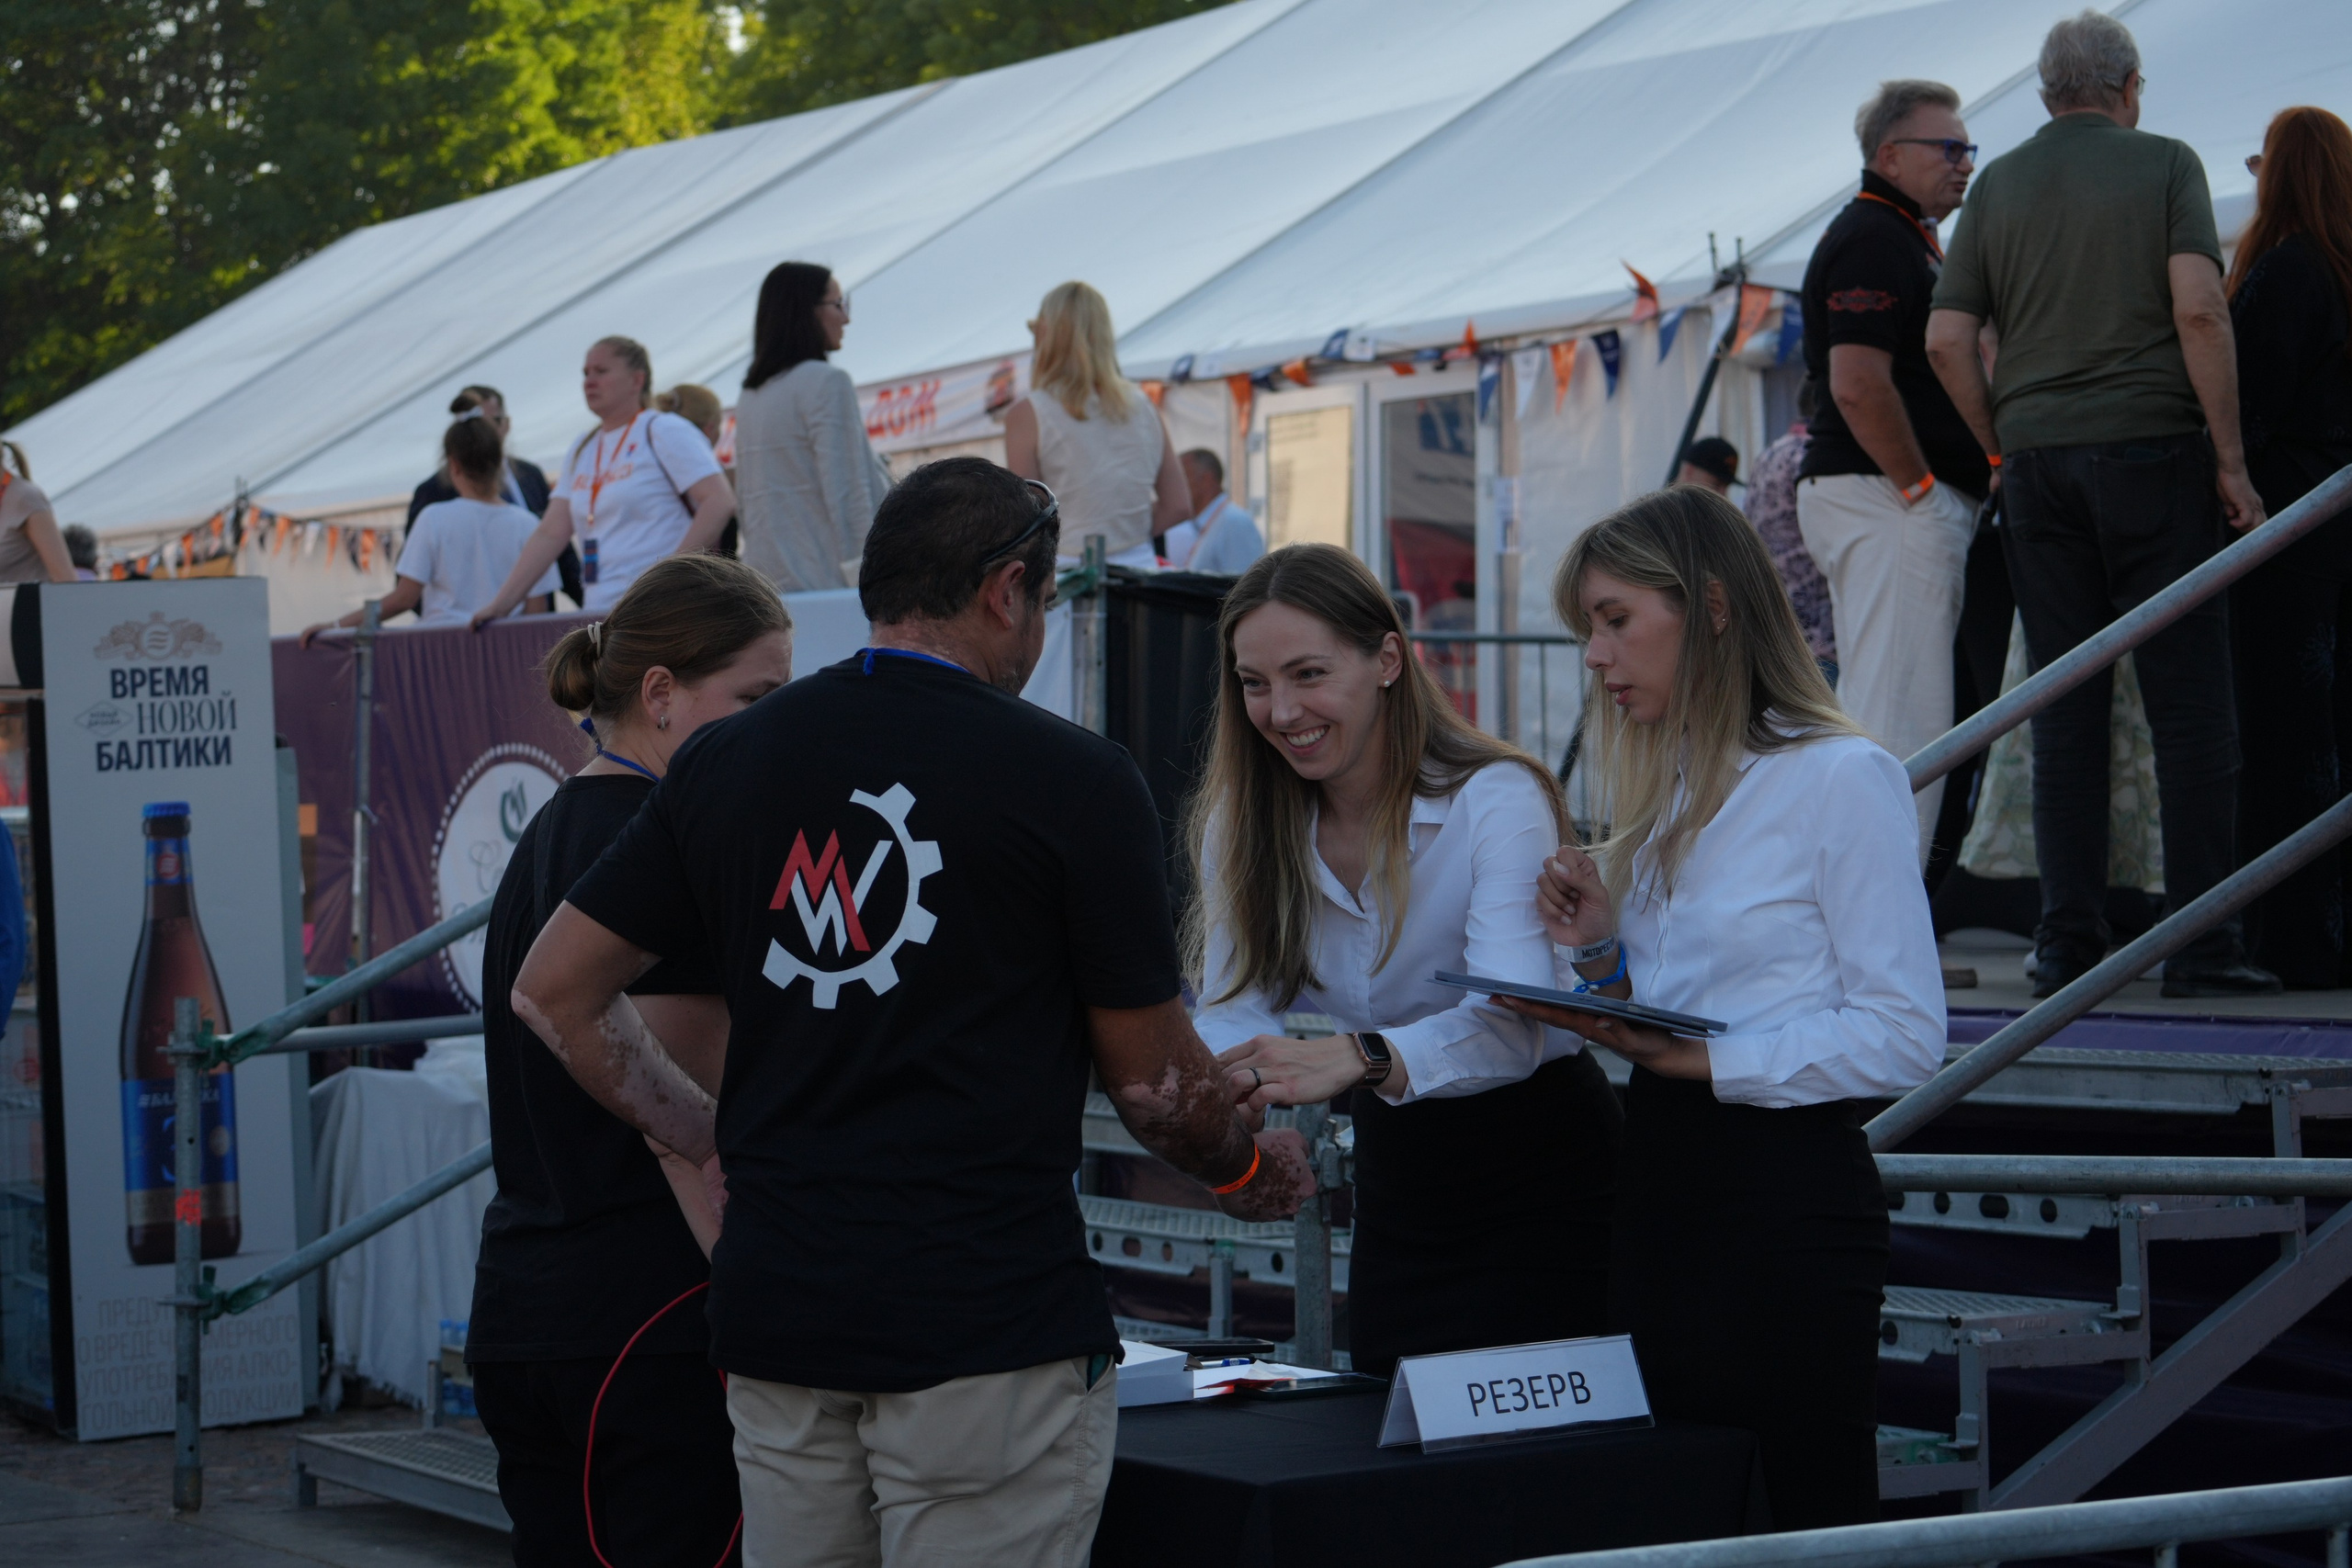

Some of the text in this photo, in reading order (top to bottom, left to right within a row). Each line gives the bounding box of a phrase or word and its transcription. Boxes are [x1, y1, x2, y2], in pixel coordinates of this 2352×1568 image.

[110, 665, 209, 699] ВРЕМЯ
[137, 691, 238, 735] НОВОЙ
[96, 736, 232, 773] БАЛТИКИ
[77, 1335, 91, 1366] О
[94, 1329, 156, 1363] ВРЕДЕ
[202, 1382, 299, 1419] ОДУКЦИИ
[1467, 1371, 1591, 1416] РЕЗЕРВ
